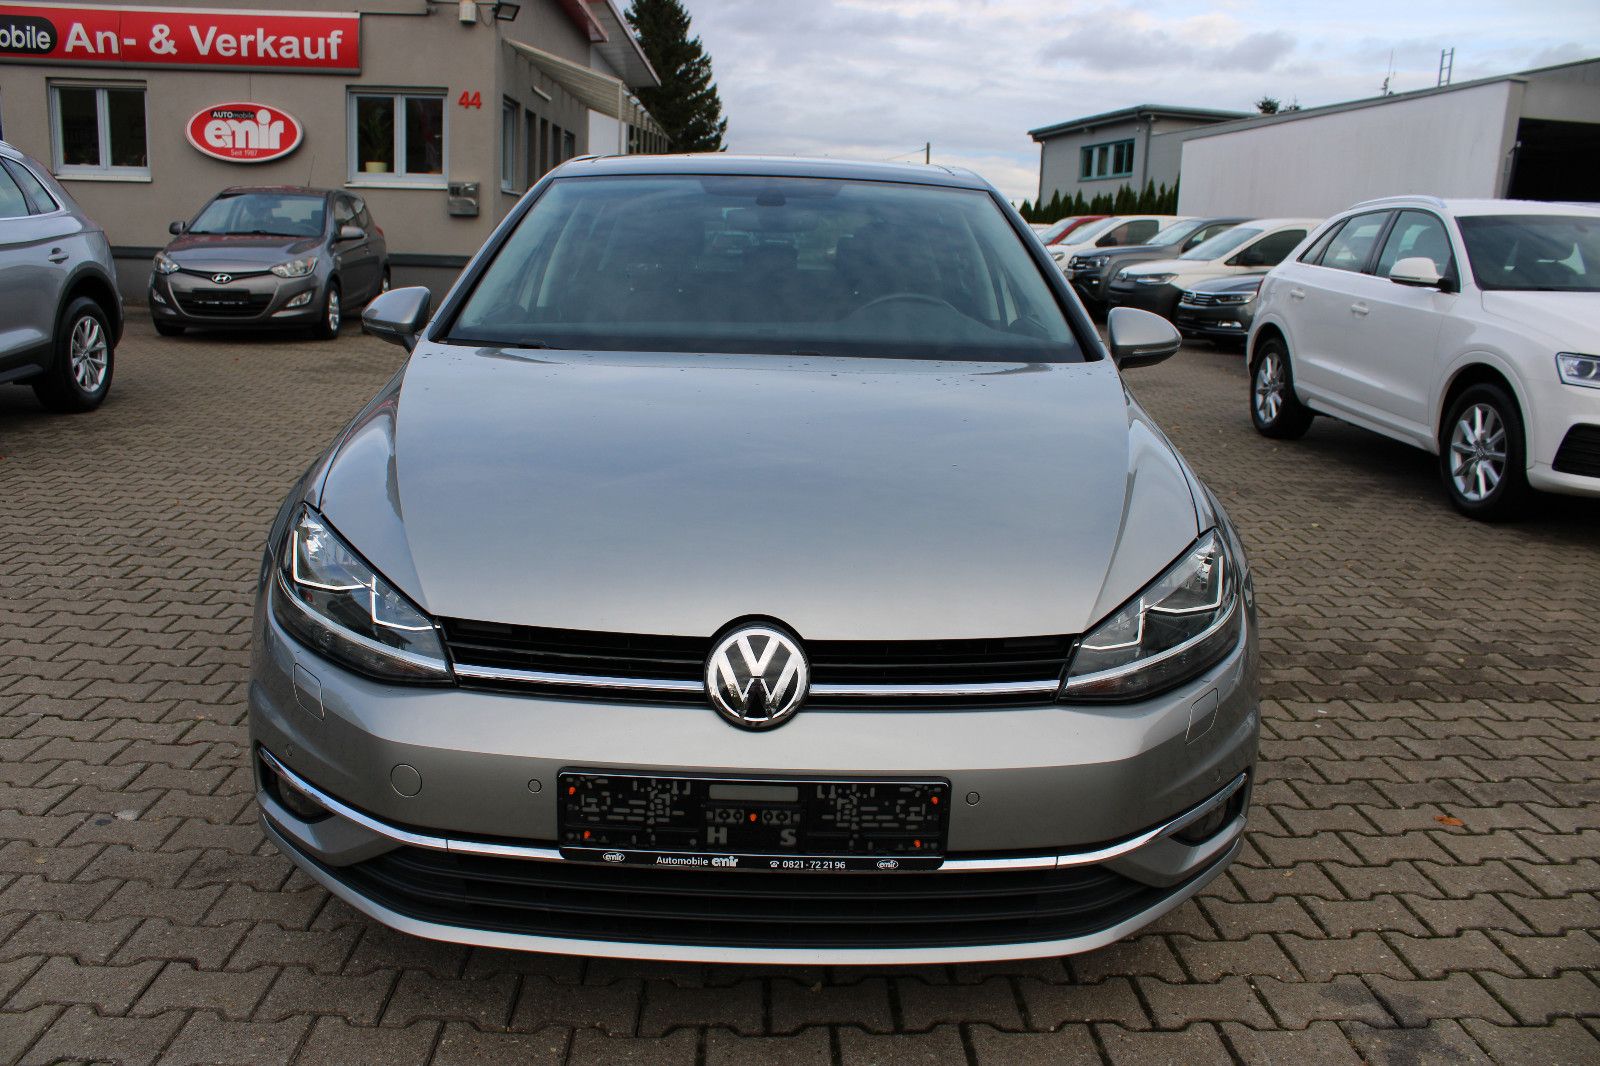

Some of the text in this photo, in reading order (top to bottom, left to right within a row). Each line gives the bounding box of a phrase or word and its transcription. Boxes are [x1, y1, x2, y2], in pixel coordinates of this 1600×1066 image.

[64, 22, 344, 60] An- & Verkauf
[458, 90, 482, 110] 44
[204, 109, 285, 150] emir
[656, 855, 739, 868] Automobile emir
